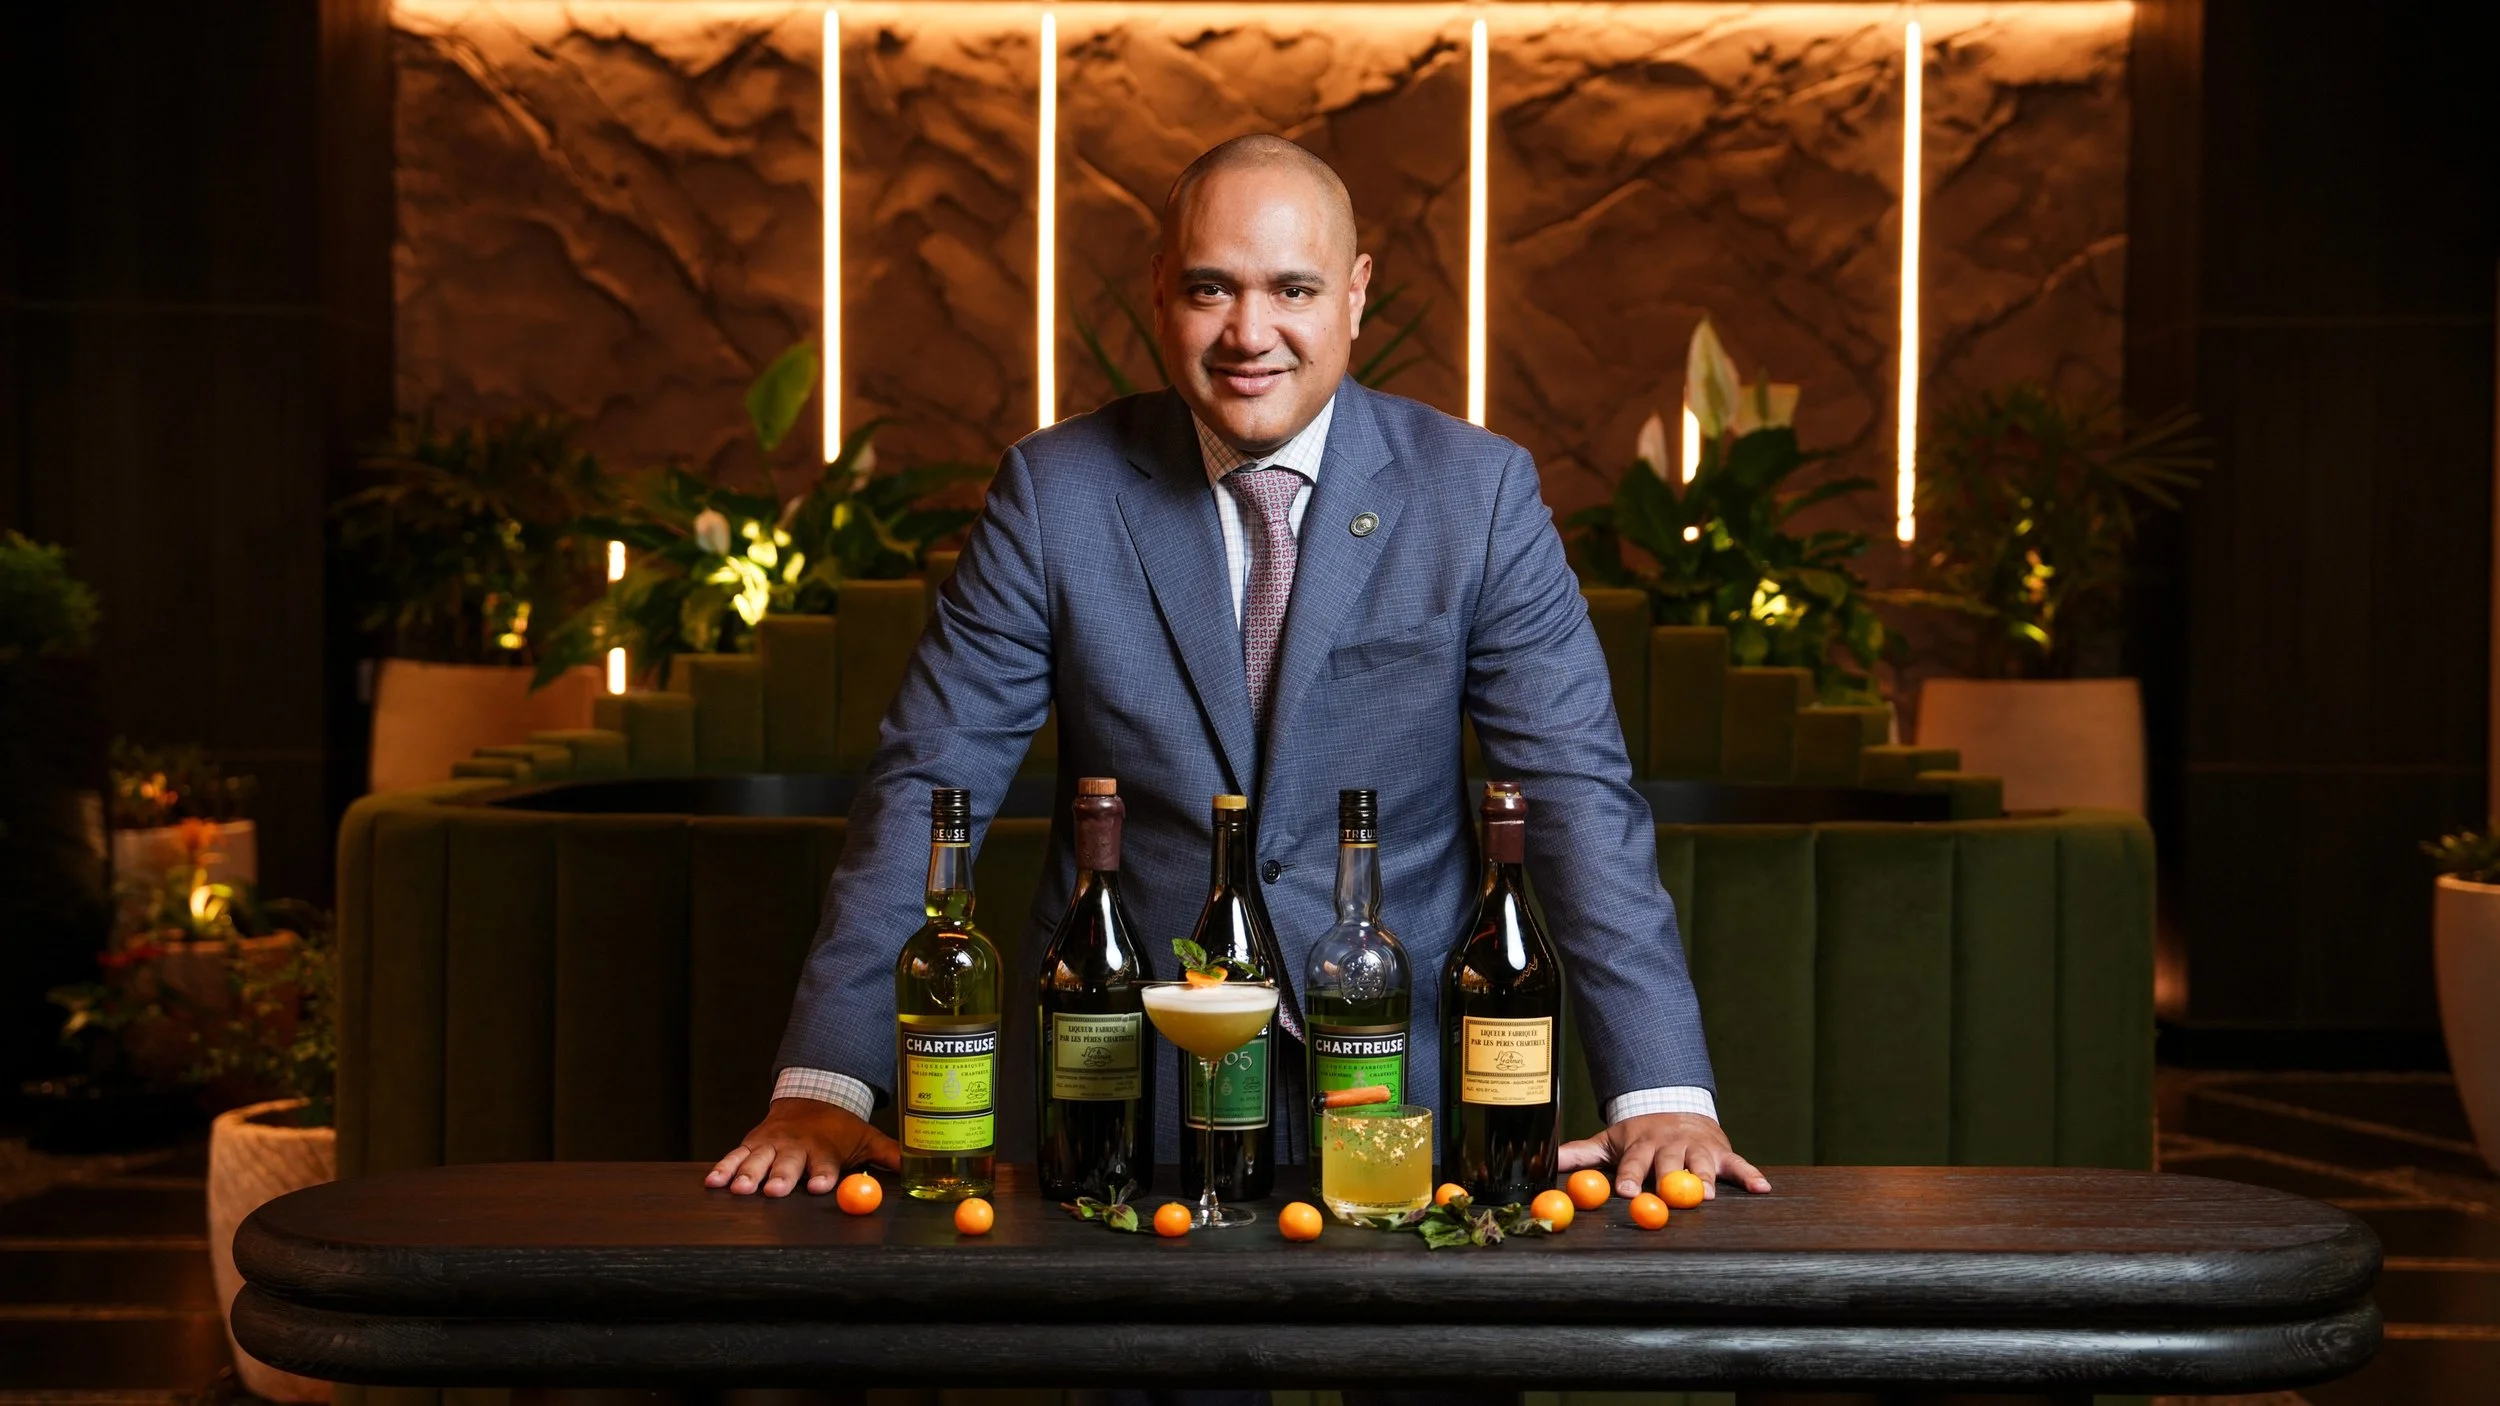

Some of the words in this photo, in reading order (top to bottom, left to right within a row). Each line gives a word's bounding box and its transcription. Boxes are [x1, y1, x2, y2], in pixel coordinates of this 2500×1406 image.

[1068, 1025, 1093, 1033] LIQUEUR
[1095, 1025, 1127, 1033] FABRIQUE
[1480, 1029, 1506, 1037] LIQUEUR
[1060, 1034, 1069, 1042] PAR
[906, 1037, 995, 1053] CHARTREUSE
[1315, 1038, 1403, 1055] CHARTREUSE
[1496, 1039, 1514, 1047] PÈRES
[1516, 1039, 1546, 1047] CHARTREUX
